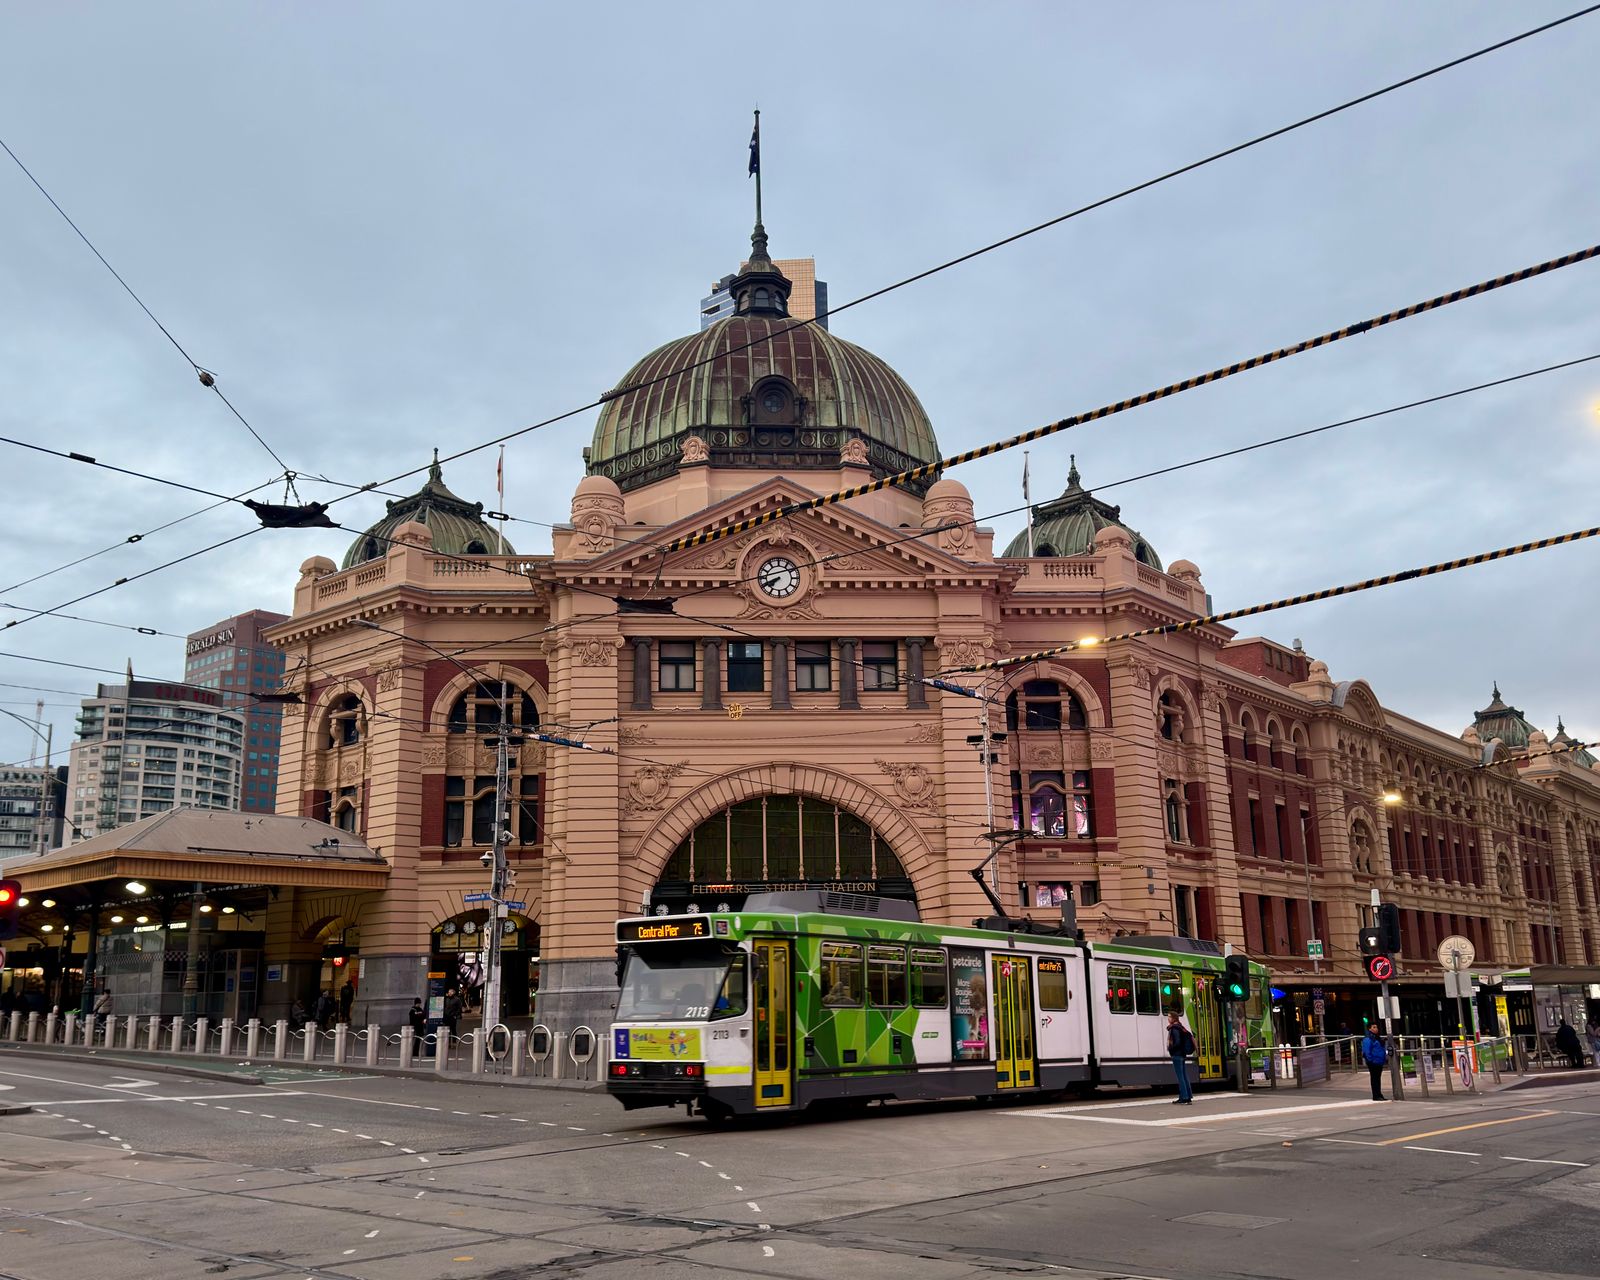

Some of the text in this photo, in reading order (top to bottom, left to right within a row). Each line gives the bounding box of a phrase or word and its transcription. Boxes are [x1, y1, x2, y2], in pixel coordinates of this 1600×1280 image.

[217, 628, 235, 643] SUN
[692, 882, 876, 894] FLINDERS STREET STATION
[638, 925, 664, 938] Central
[665, 924, 679, 937] Pier
[952, 956, 982, 968] petcircle
[685, 1006, 709, 1018] 2113
[713, 1029, 729, 1040] 2113
